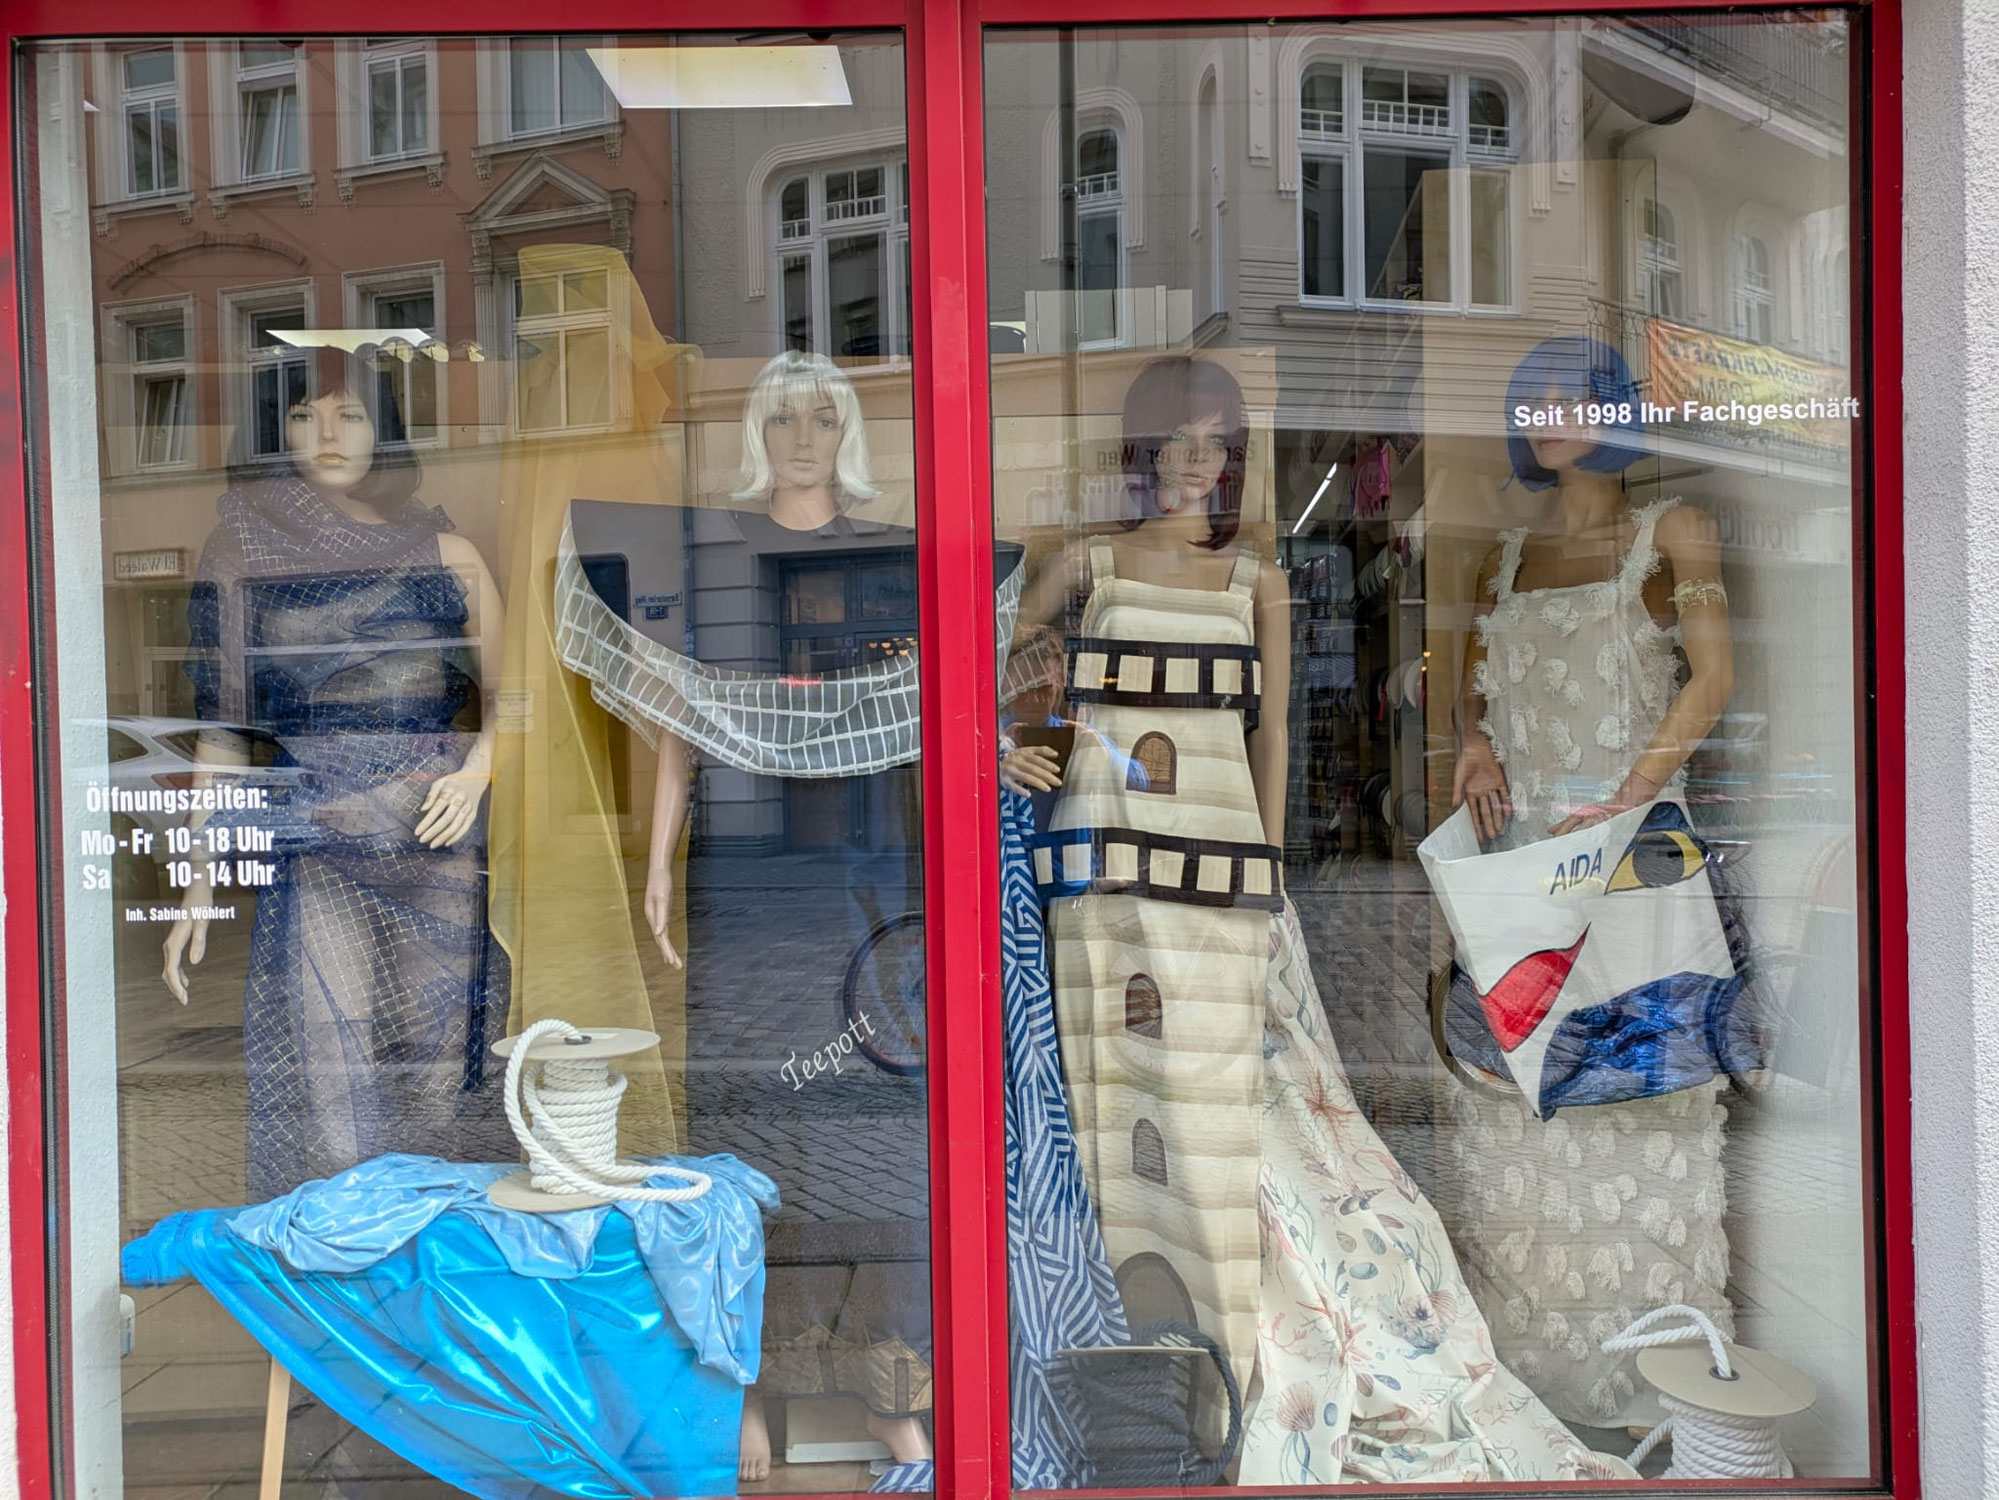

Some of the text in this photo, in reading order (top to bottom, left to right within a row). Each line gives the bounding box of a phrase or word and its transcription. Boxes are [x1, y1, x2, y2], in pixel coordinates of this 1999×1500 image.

[1514, 397, 1860, 428] Seit 1998 Ihr Fachgeschäft
[86, 781, 268, 813] Öffnungszeiten:
[236, 826, 275, 852] Uhr
[82, 864, 110, 890] Sa
[237, 860, 276, 886] Uhr
[1549, 847, 1602, 896] AIDA
[126, 906, 235, 922] Inh. Sabine Wöhlert
[780, 1010, 876, 1092] Teepott
